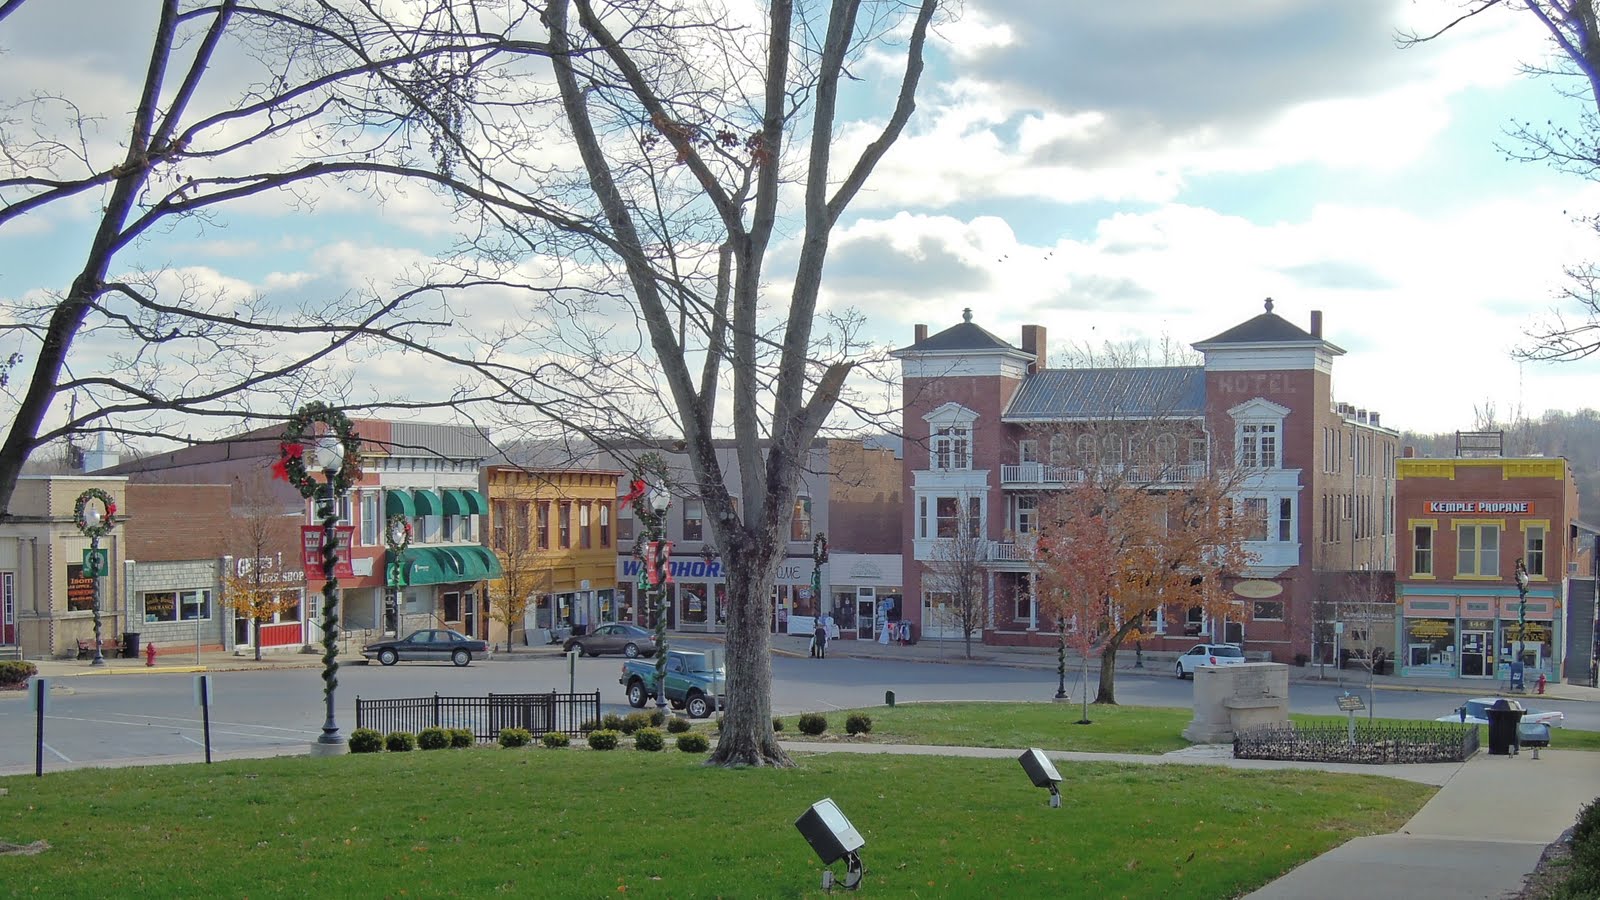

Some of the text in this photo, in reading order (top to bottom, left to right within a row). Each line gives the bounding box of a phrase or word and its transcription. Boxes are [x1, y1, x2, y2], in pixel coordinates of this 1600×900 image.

[1217, 373, 1297, 393] HOTEL
[1430, 502, 1529, 514] KEMPLE PROPANE
[282, 571, 304, 582] SHOP
